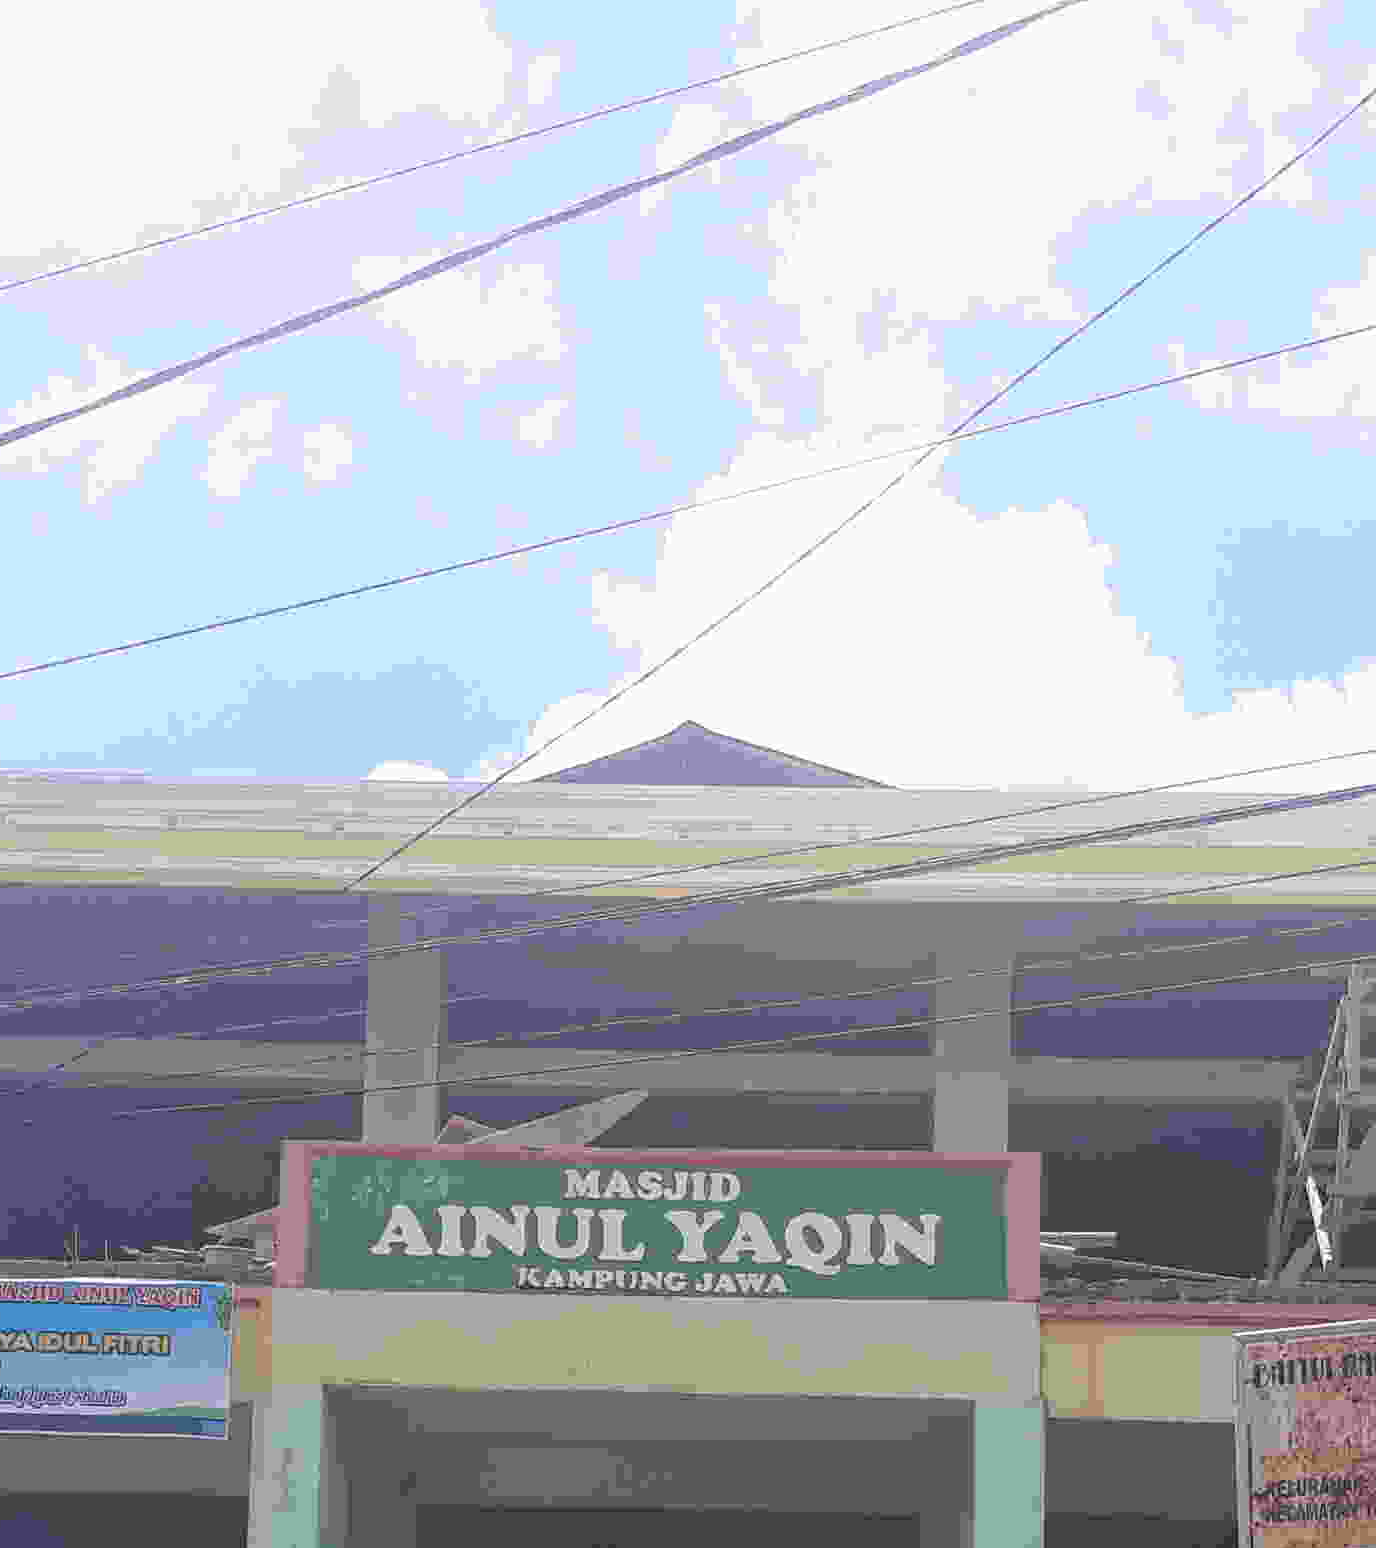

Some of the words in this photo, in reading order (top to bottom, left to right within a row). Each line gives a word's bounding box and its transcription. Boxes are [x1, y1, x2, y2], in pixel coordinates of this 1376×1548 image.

[562, 1167, 742, 1201] MASJID
[370, 1204, 646, 1262] AINUL
[664, 1208, 941, 1275] YAQIN
[514, 1263, 690, 1294] KAMPUNG
[694, 1271, 789, 1295] JAWA
